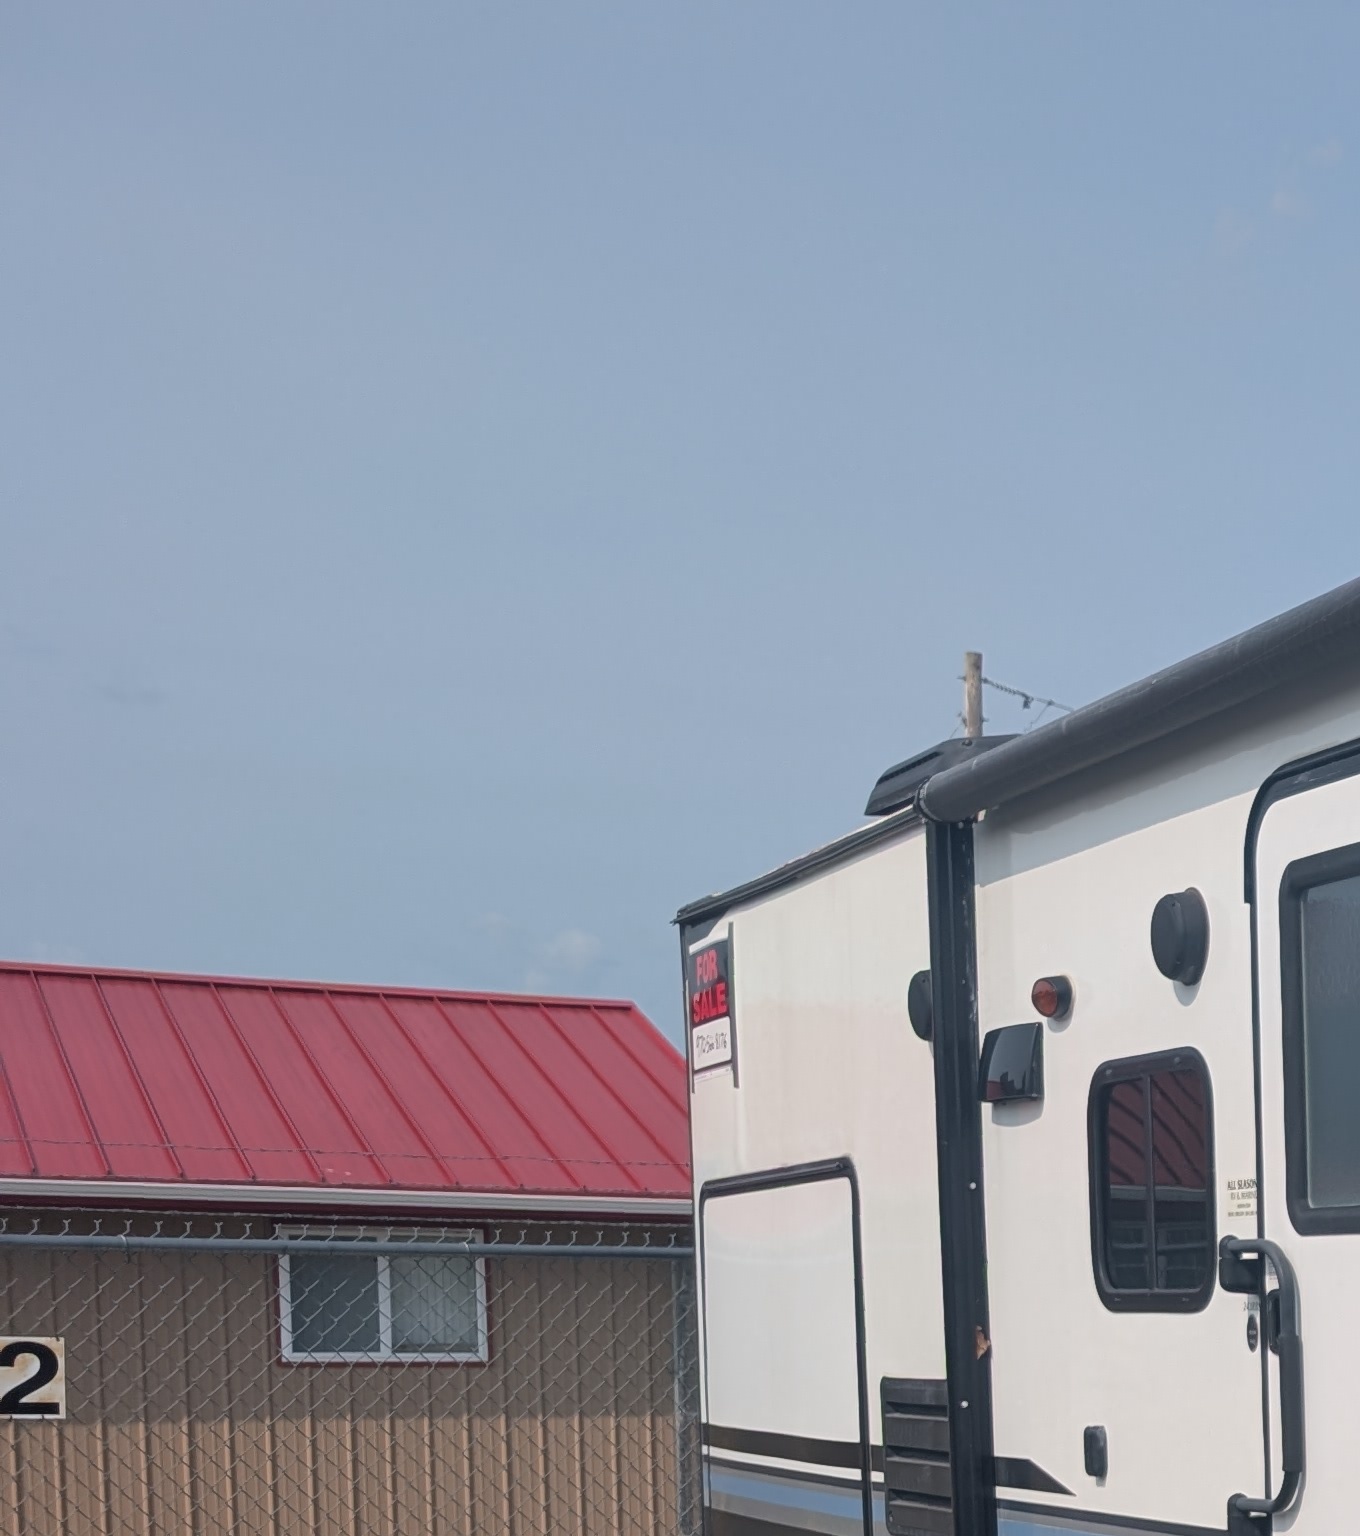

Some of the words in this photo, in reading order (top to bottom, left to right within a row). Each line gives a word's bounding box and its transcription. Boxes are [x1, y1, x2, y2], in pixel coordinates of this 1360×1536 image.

[695, 949, 718, 986] FOR
[692, 981, 728, 1023] SALE
[0, 1341, 60, 1414] 2
